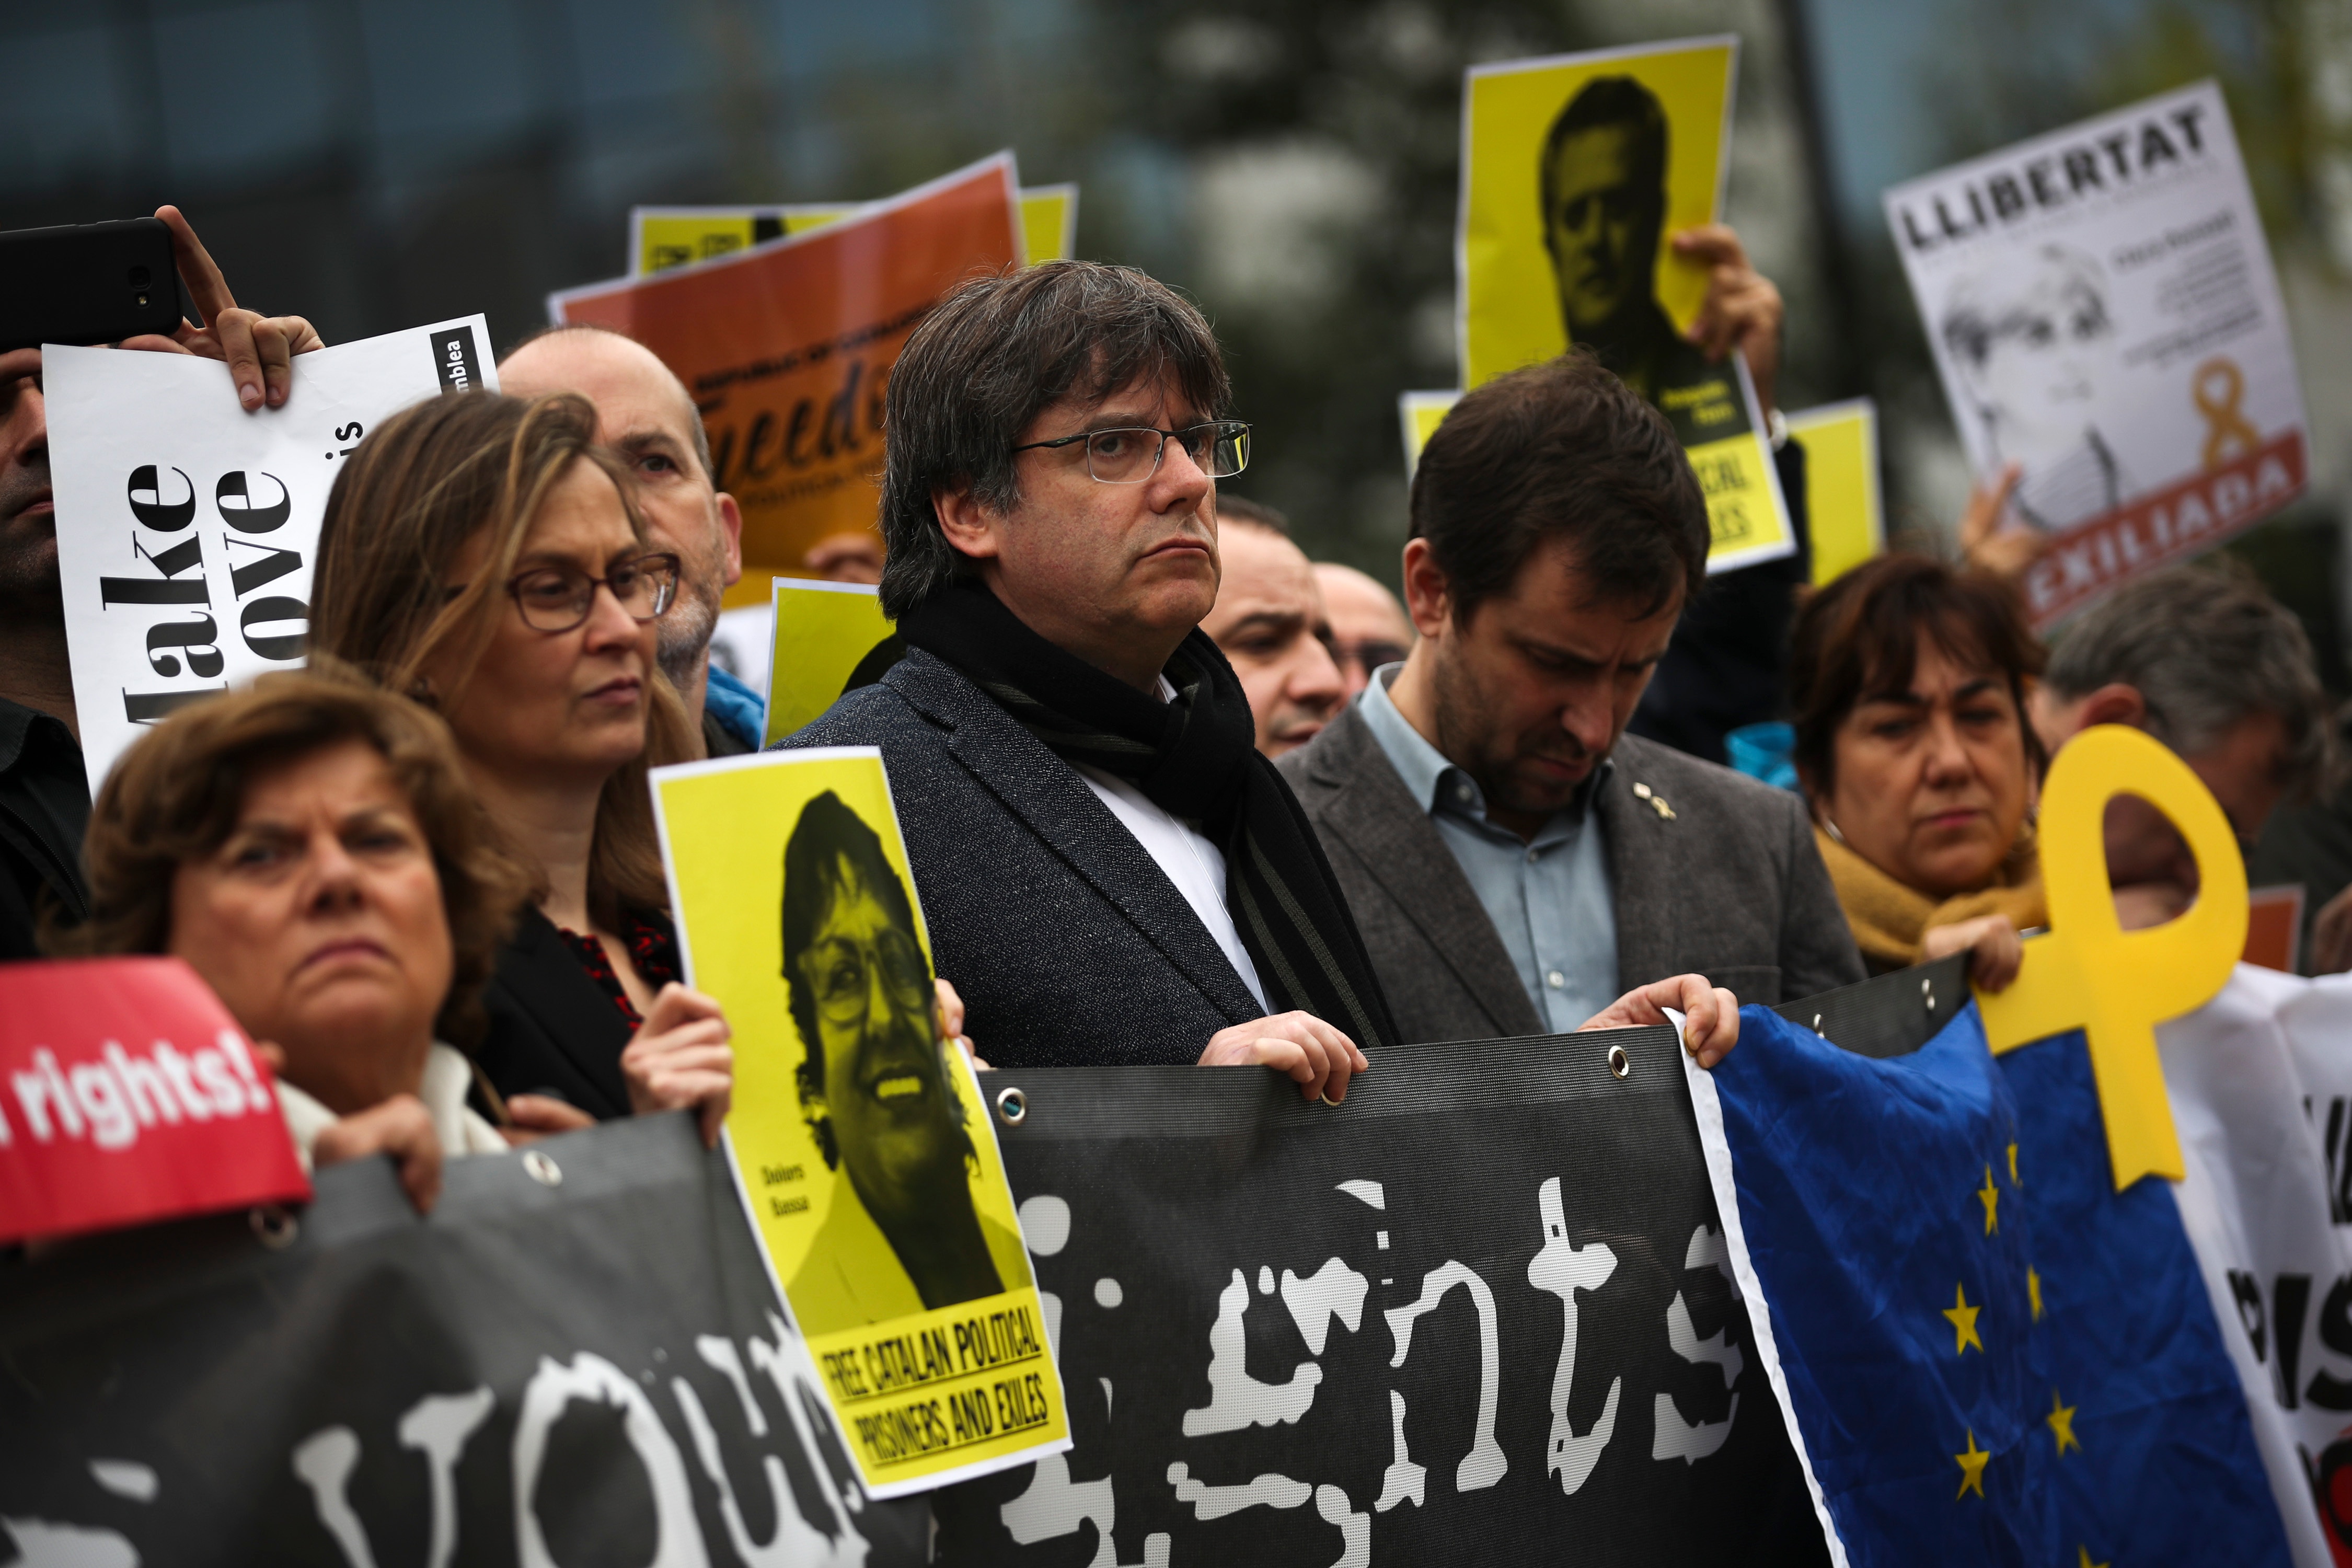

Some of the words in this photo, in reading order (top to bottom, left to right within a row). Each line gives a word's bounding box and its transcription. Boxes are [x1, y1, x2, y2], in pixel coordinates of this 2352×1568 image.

[1899, 106, 2208, 251] LLIBERTAT
[216, 470, 311, 661] ove
[2026, 454, 2292, 614] EXILIADA
[10, 1029, 270, 1151] rights!
[822, 1347, 869, 1397] FREE
[862, 1325, 953, 1390] CATALAN
[953, 1305, 1041, 1370] POLITICAL
[854, 1399, 950, 1460] PRISONERS
[948, 1387, 993, 1443] AND
[994, 1370, 1049, 1431] EXILES
